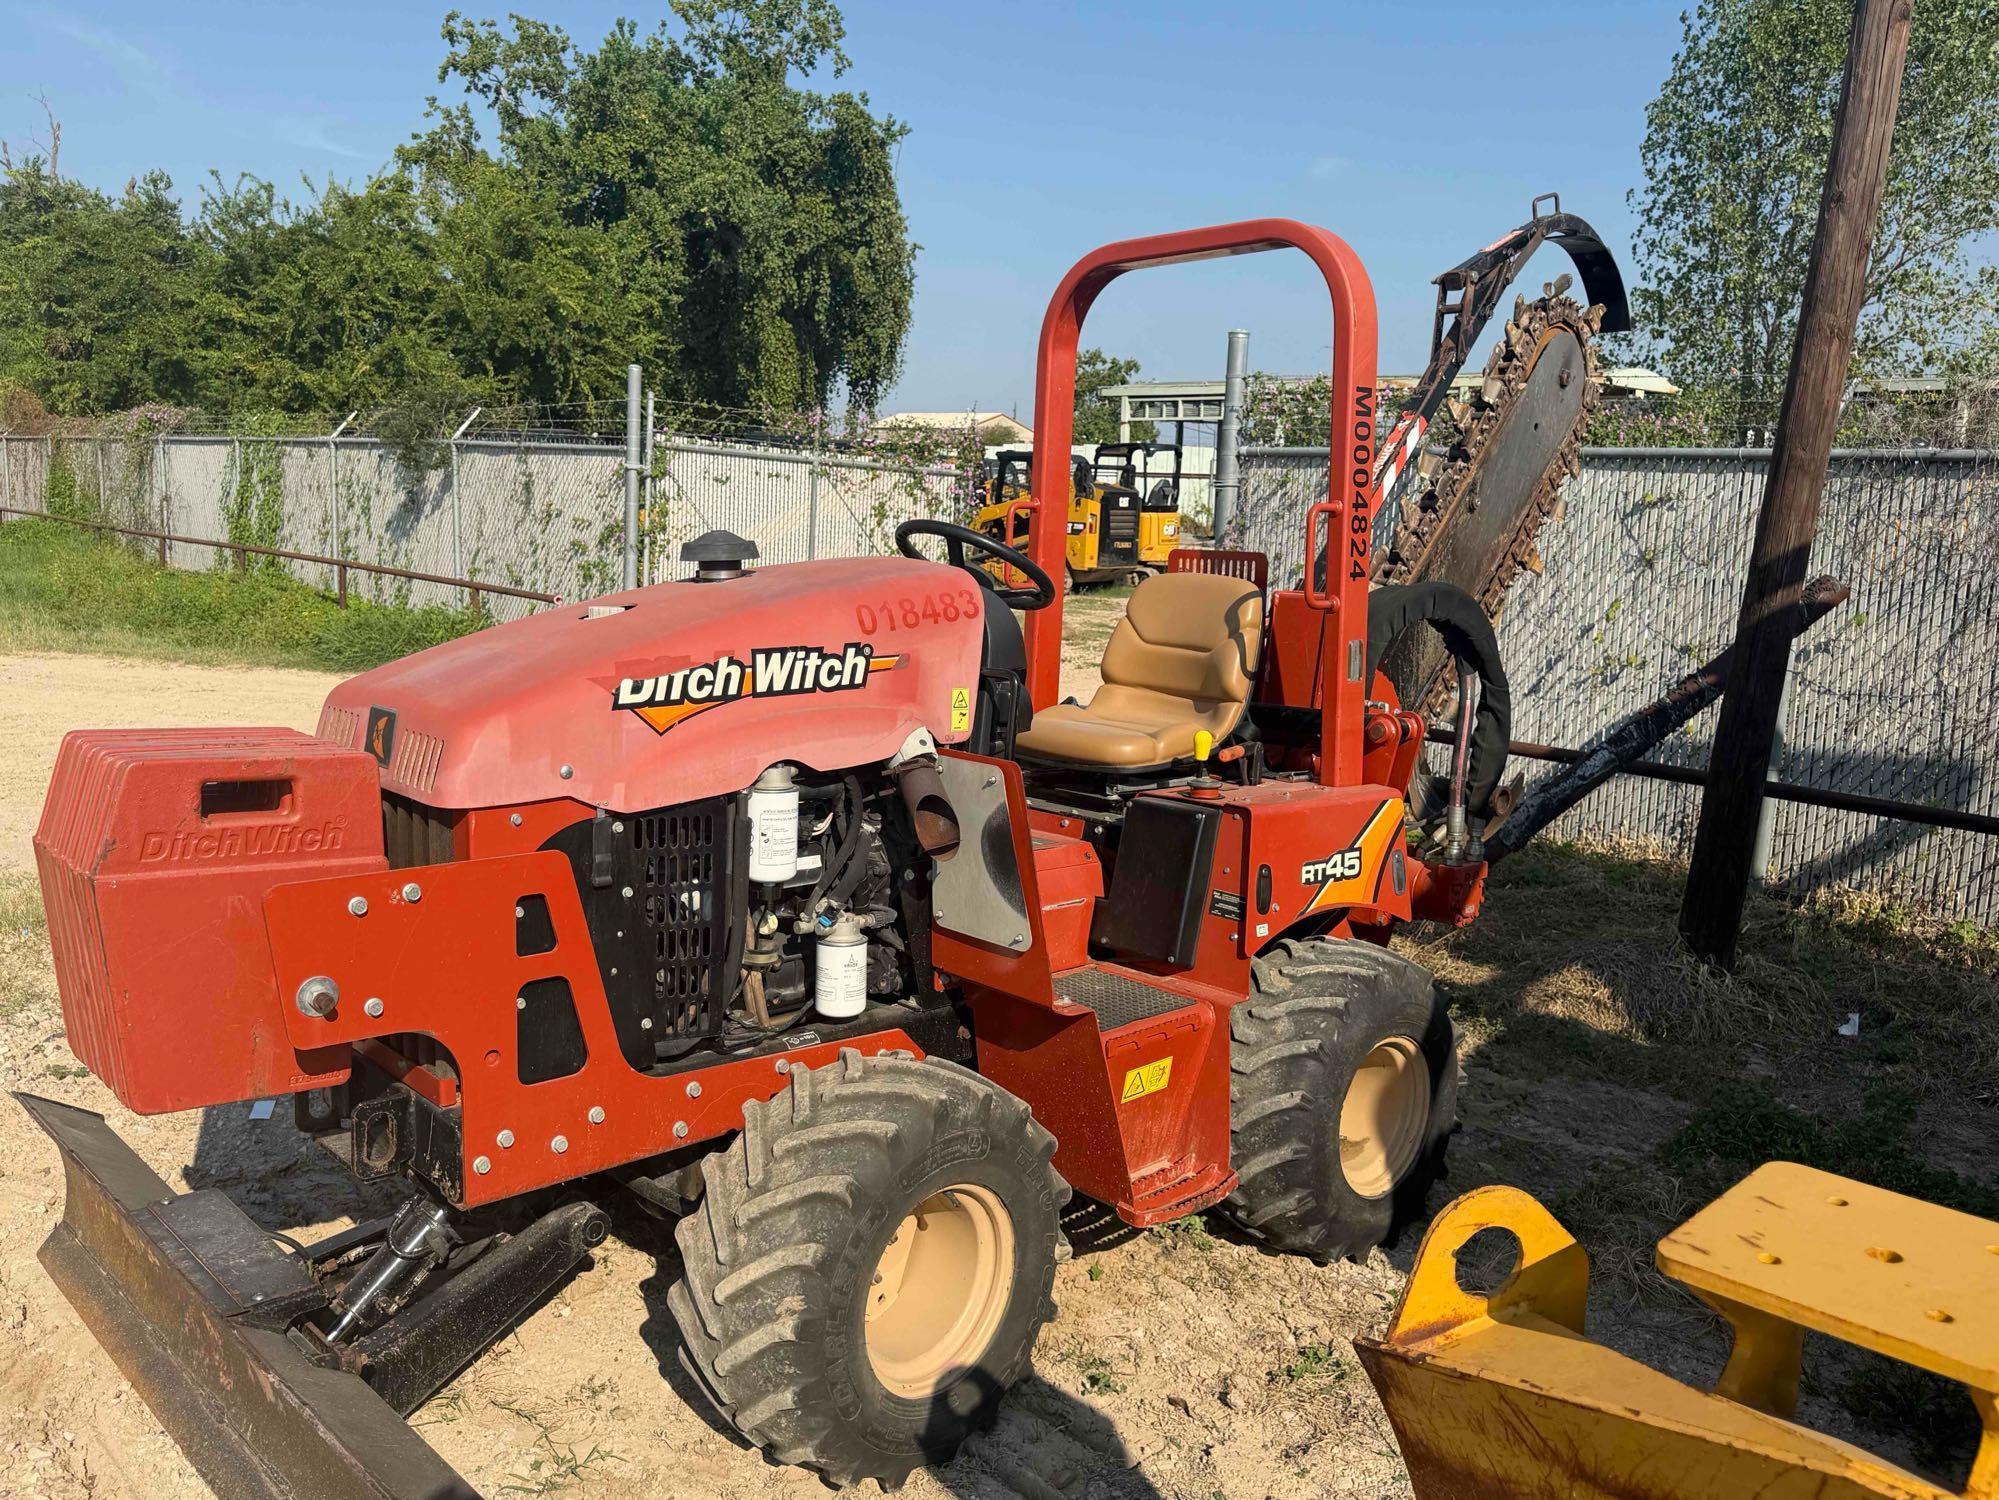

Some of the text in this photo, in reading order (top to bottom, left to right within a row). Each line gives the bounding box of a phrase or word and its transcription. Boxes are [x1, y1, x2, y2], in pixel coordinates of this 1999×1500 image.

[1350, 386, 1373, 581] M0004824
[855, 589, 980, 636] 018483
[754, 647, 866, 693] Witch
[139, 821, 345, 862] Ditch Witch
[1301, 850, 1361, 884] RT45
